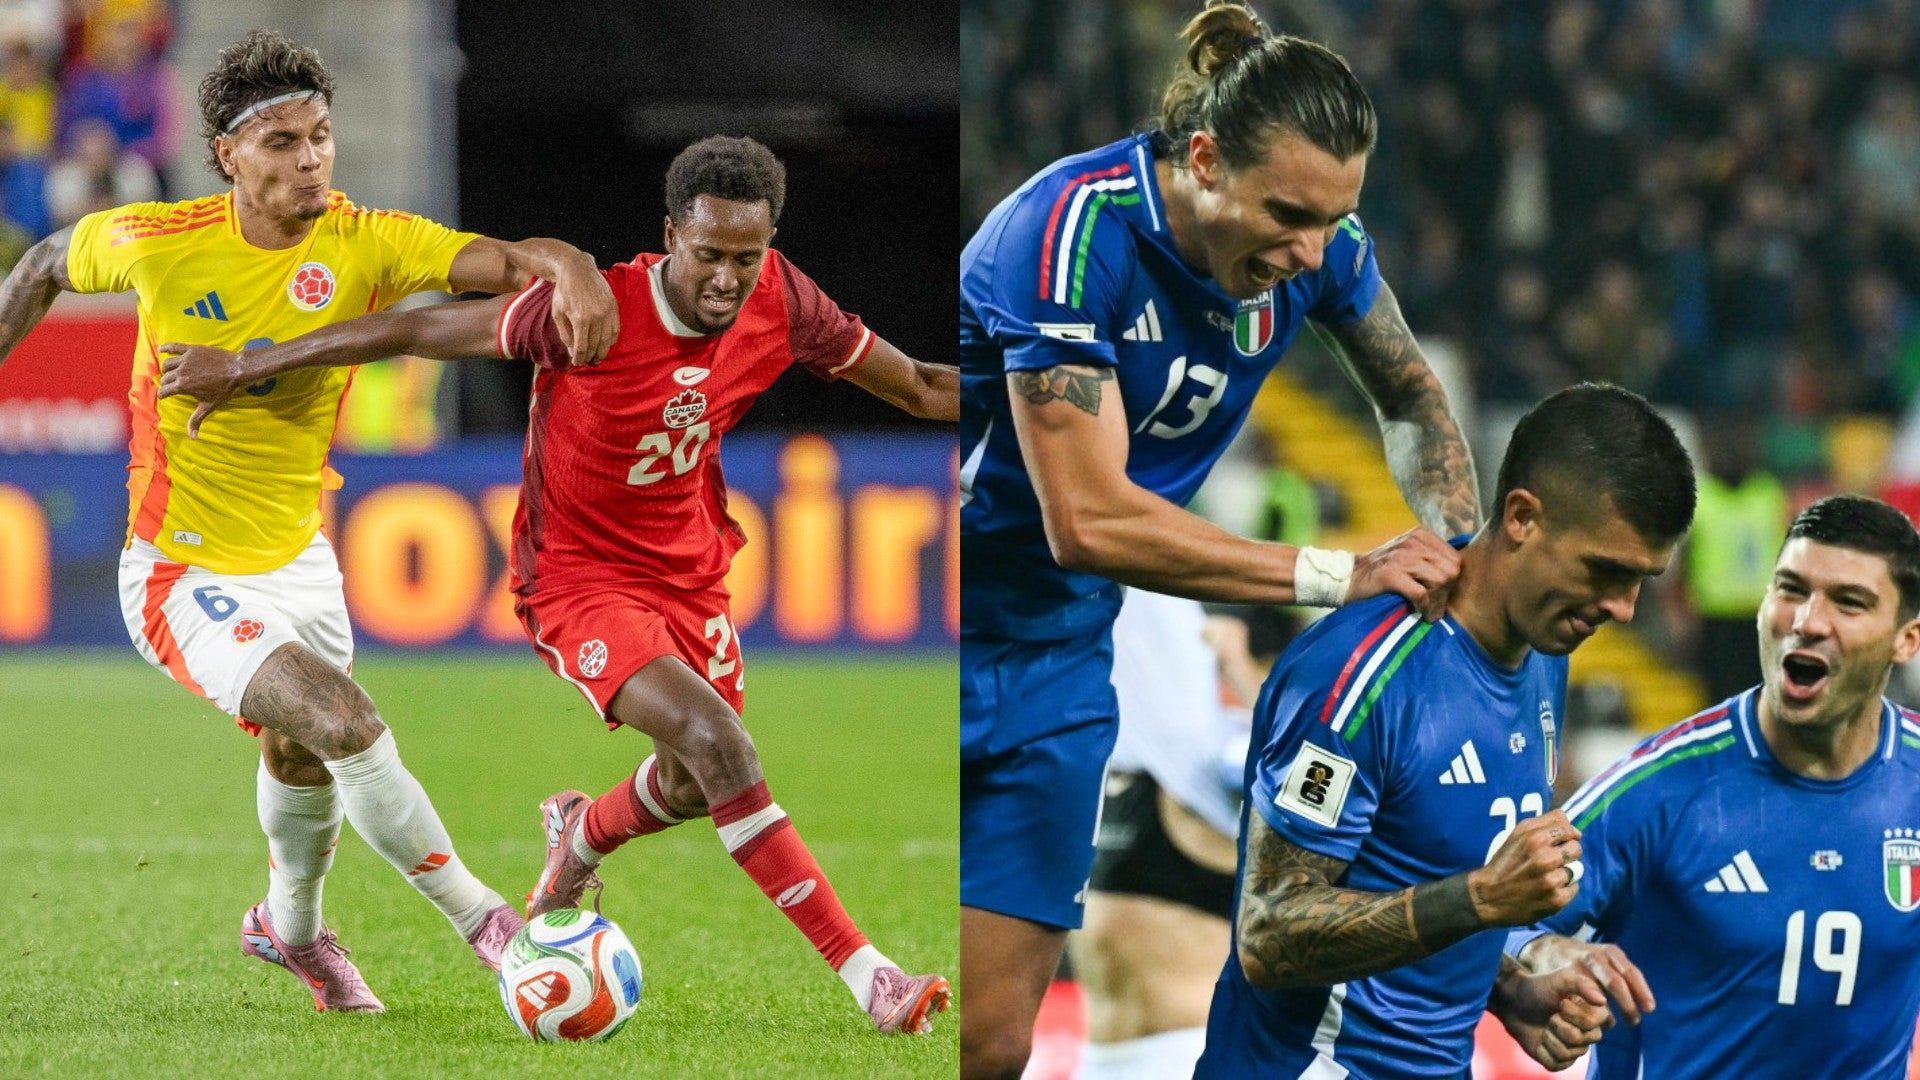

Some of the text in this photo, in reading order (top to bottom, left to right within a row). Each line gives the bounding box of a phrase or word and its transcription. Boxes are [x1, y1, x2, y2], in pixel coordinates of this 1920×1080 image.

[665, 404, 704, 416] CANADA
[1134, 356, 1228, 439] 13
[627, 421, 711, 486] 20
[193, 586, 239, 622] 6
[582, 645, 604, 672] CANADA
[705, 613, 744, 691] 2
[1778, 910, 1862, 1006] 19
